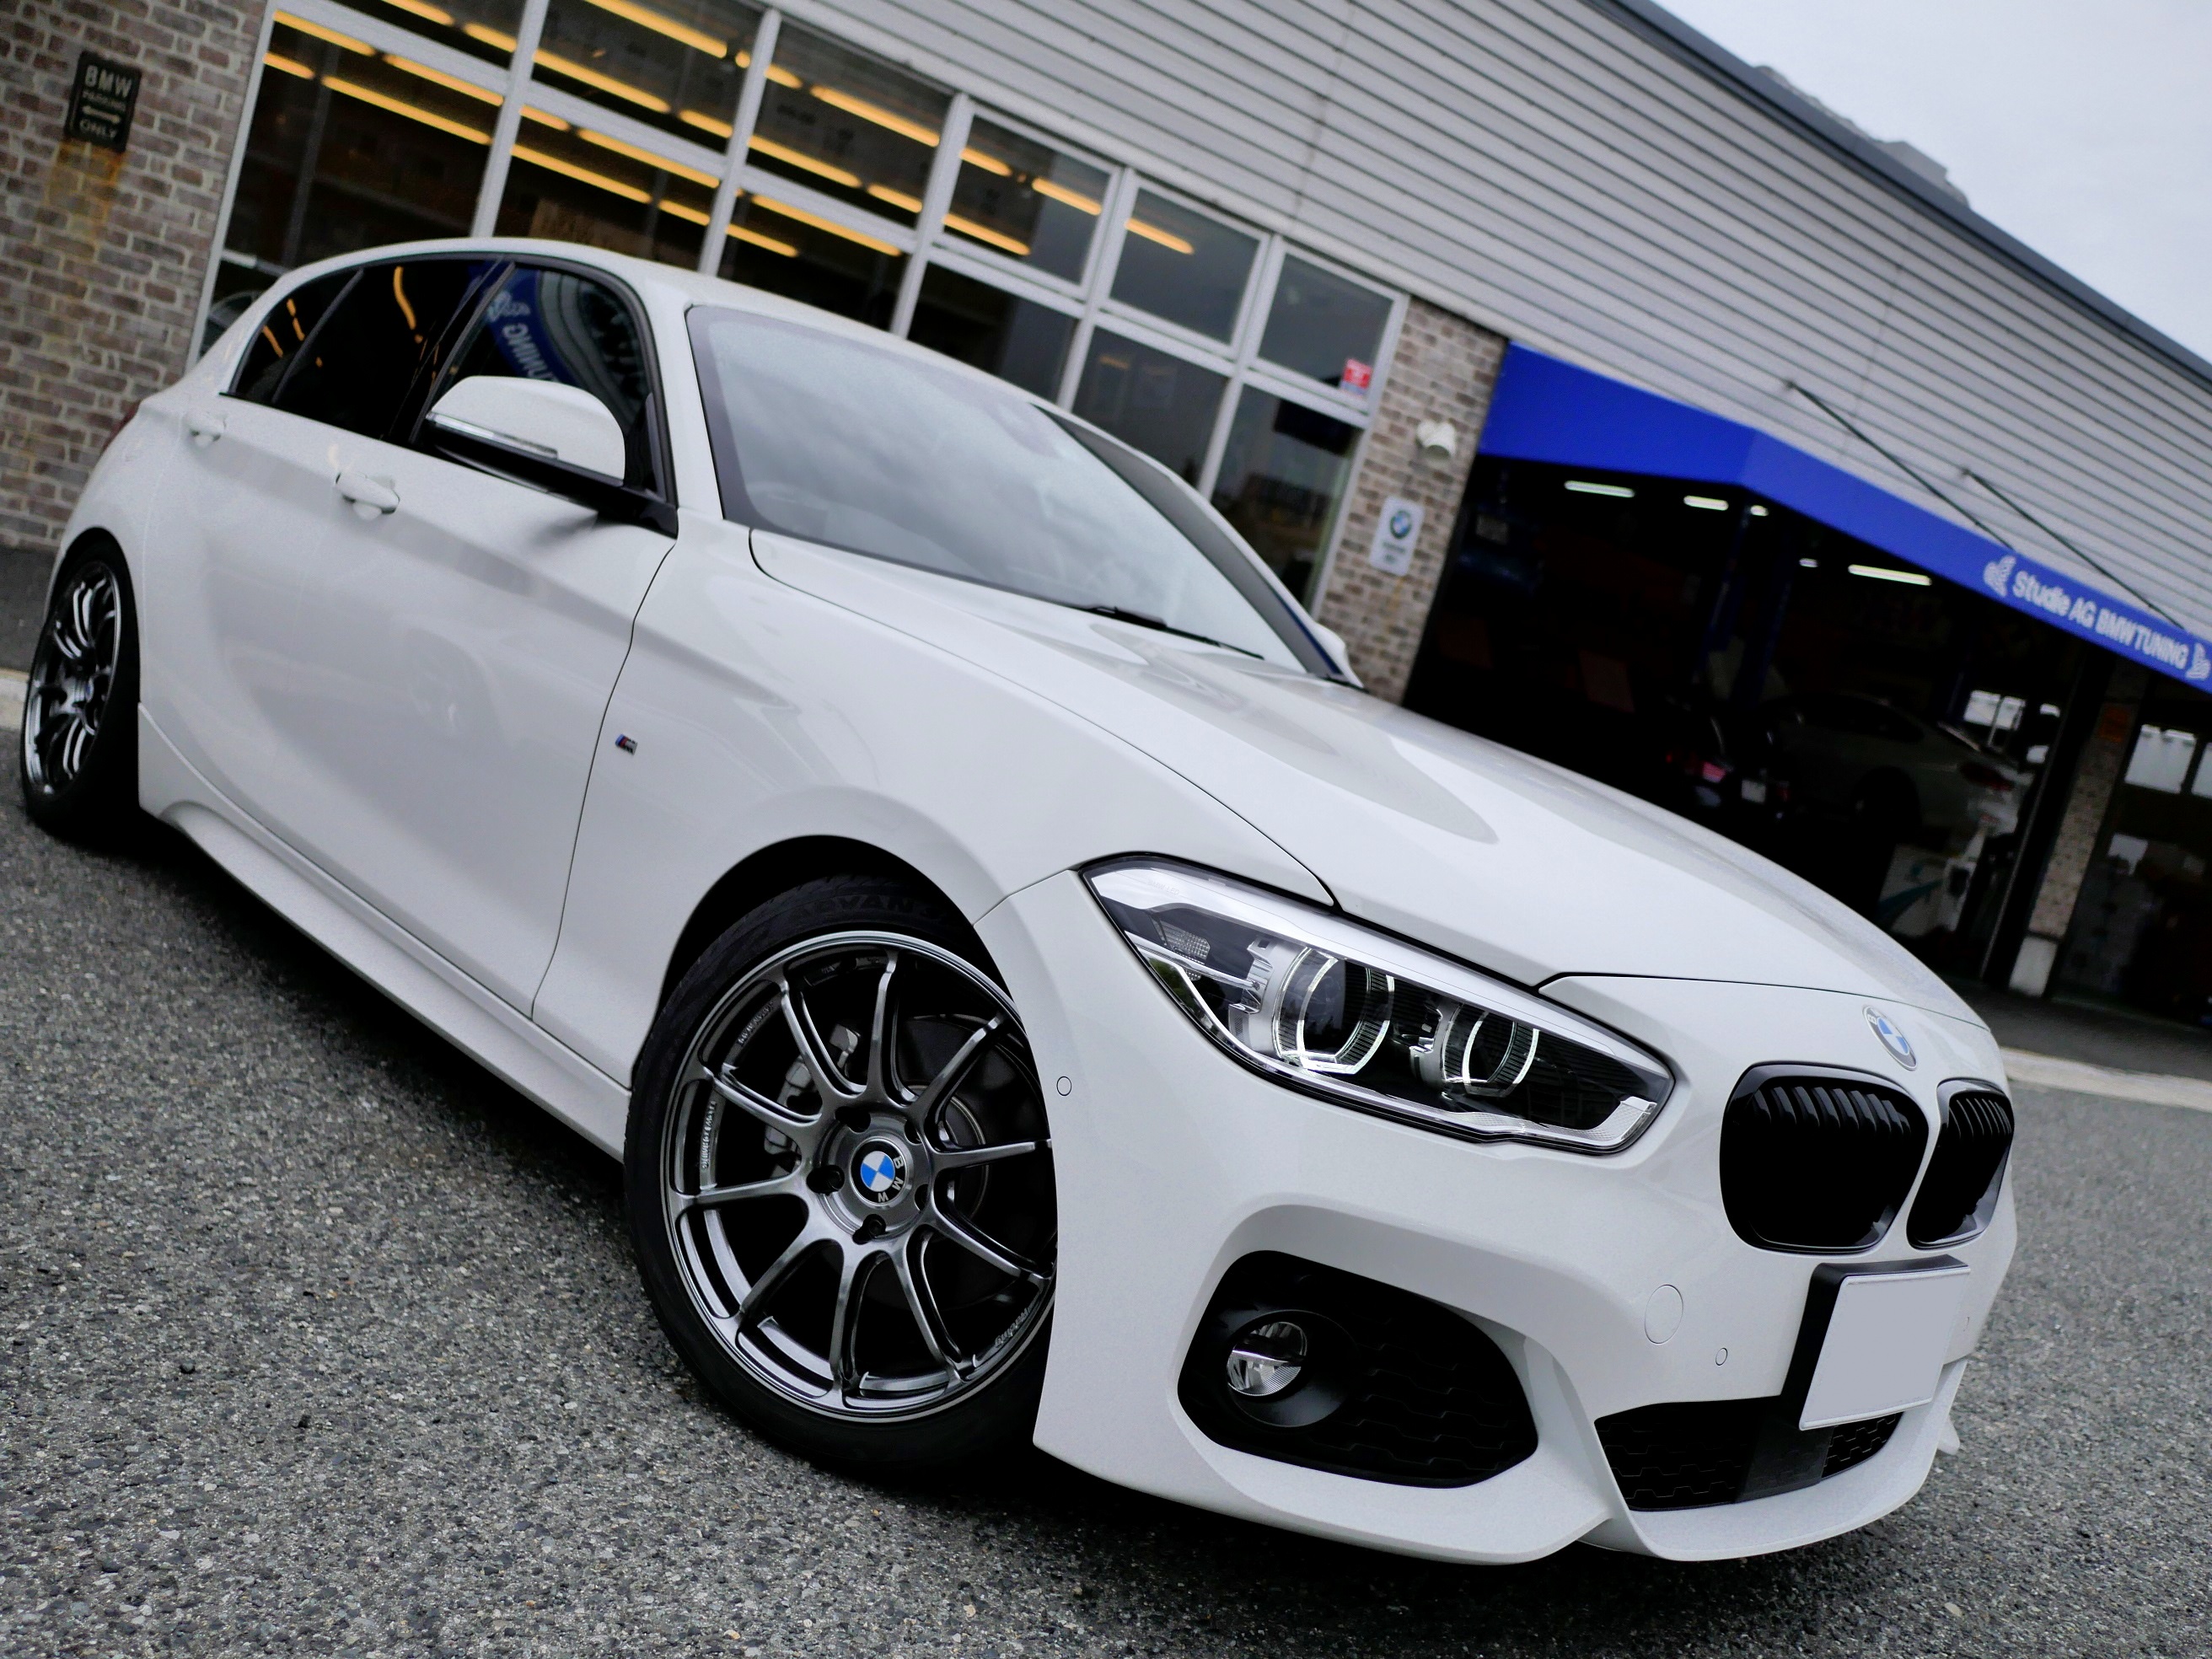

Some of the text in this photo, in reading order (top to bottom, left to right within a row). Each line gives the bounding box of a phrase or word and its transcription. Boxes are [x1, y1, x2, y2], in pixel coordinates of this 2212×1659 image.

[85, 65, 132, 98] BMW
[2013, 571, 2190, 669] Studie AG BMW TUNING
[878, 1156, 904, 1203] BMW
